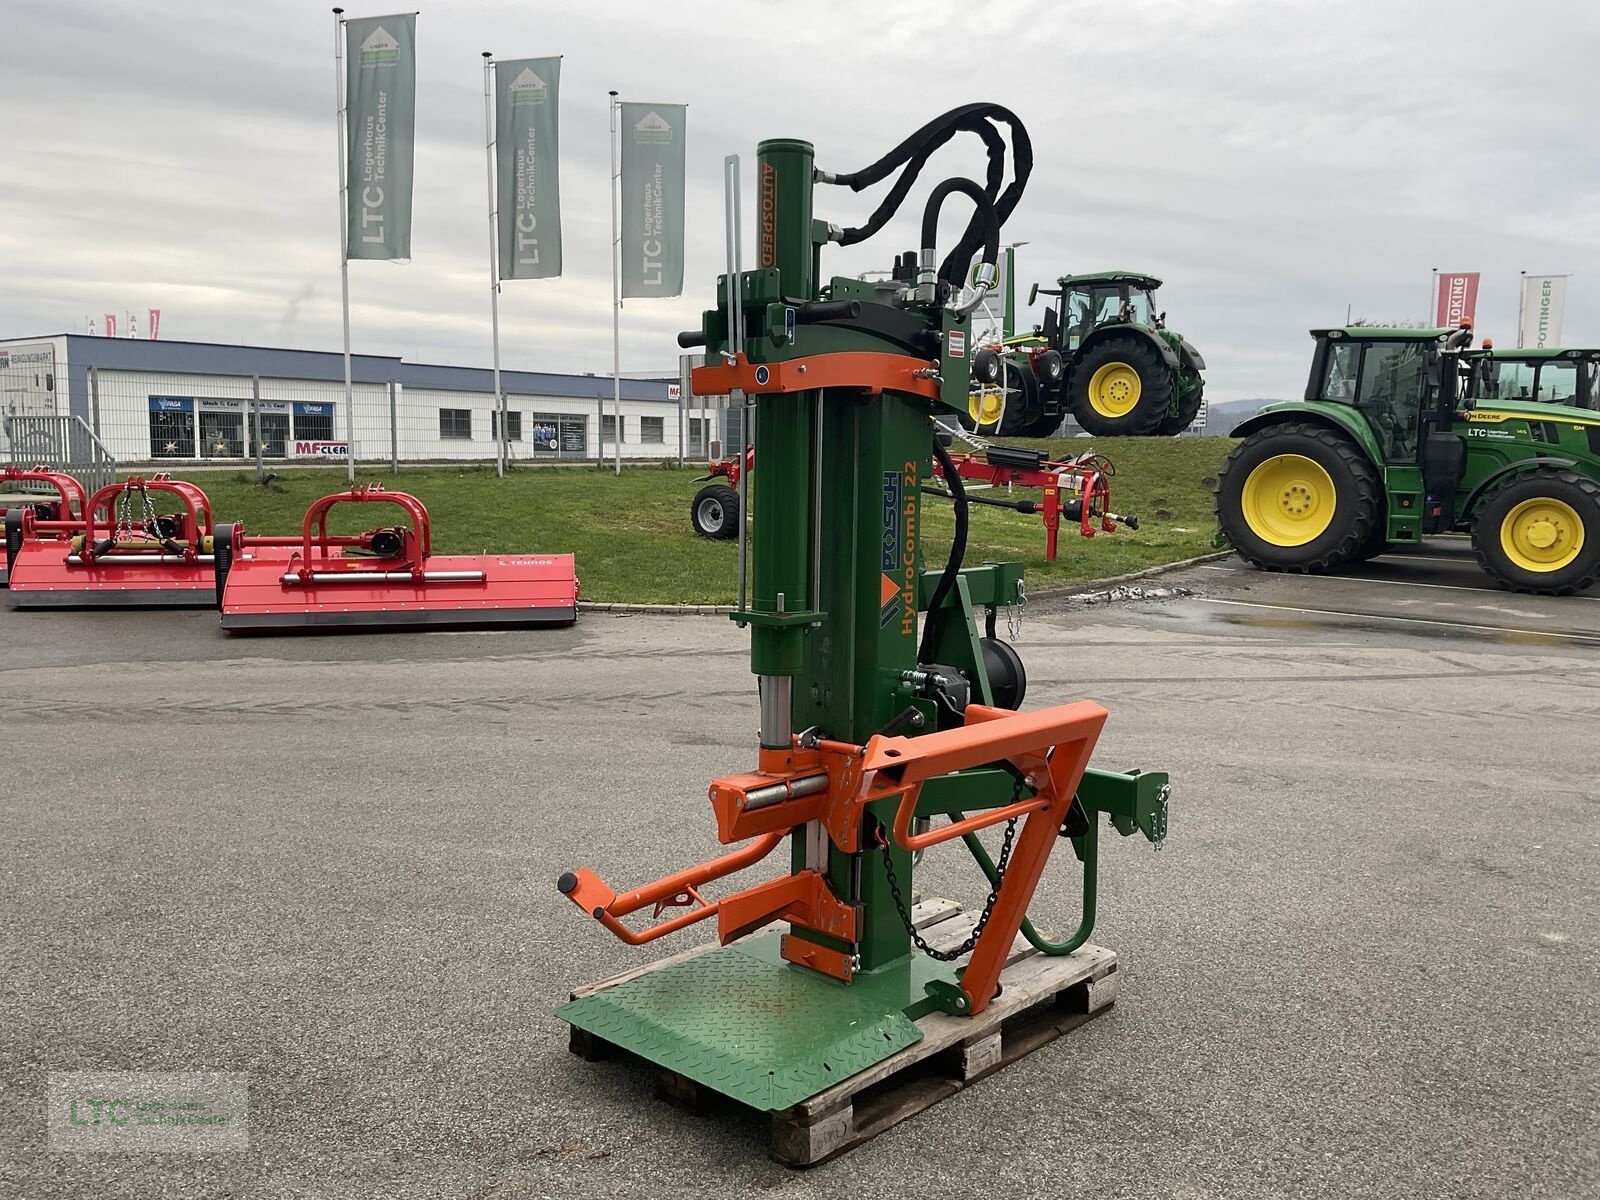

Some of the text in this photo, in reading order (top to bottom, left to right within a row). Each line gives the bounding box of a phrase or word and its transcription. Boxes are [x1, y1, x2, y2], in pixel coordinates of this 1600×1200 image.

[363, 115, 374, 181] Lagerhaus
[375, 91, 387, 181] TechnikCenter
[527, 126, 537, 209] TechnikCenter
[517, 149, 526, 209] Lagerhaus
[643, 183, 652, 236] Lagerhaus
[653, 163, 664, 236] TechnikCenter
[361, 187, 385, 243] LTC
[517, 213, 540, 264] LTC
[761, 163, 775, 266] AUTOSPEED
[643, 240, 662, 285] LTC
[1449, 278, 1465, 328] ILOKING
[1468, 428, 1487, 437] LTC
[882, 471, 898, 571] POSCH
[902, 461, 917, 635] HydroCombi 22
